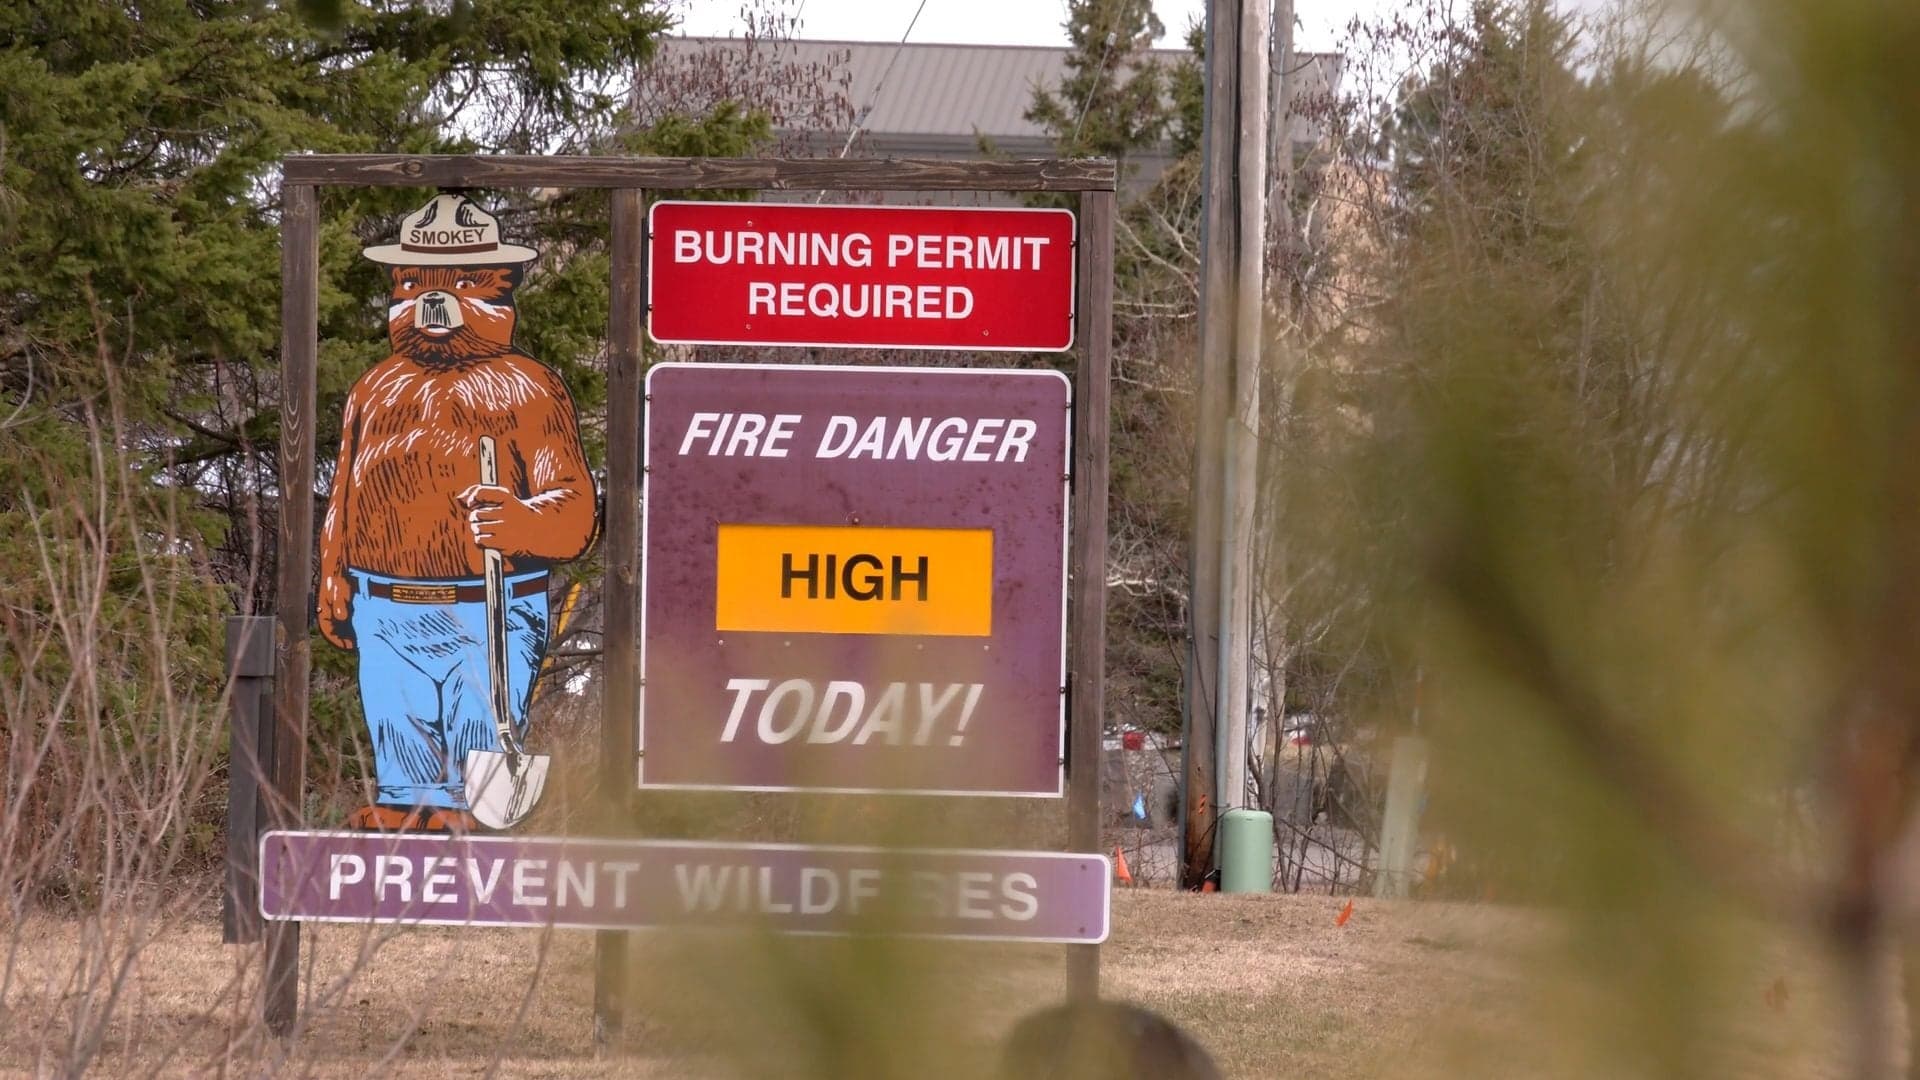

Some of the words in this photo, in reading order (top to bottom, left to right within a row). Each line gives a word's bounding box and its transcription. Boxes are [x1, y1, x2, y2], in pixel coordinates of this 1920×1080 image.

[410, 228, 485, 245] SMOKEY
[674, 230, 872, 267] BURNING
[888, 235, 1050, 270] PERMIT
[748, 282, 975, 319] REQUIRED
[678, 412, 802, 458] FIRE
[816, 415, 1037, 462] DANGER
[781, 553, 929, 601] HIGH
[720, 678, 985, 747] TODAY!
[329, 853, 640, 908] PREVENT
[674, 863, 1039, 921] WILDFRES
